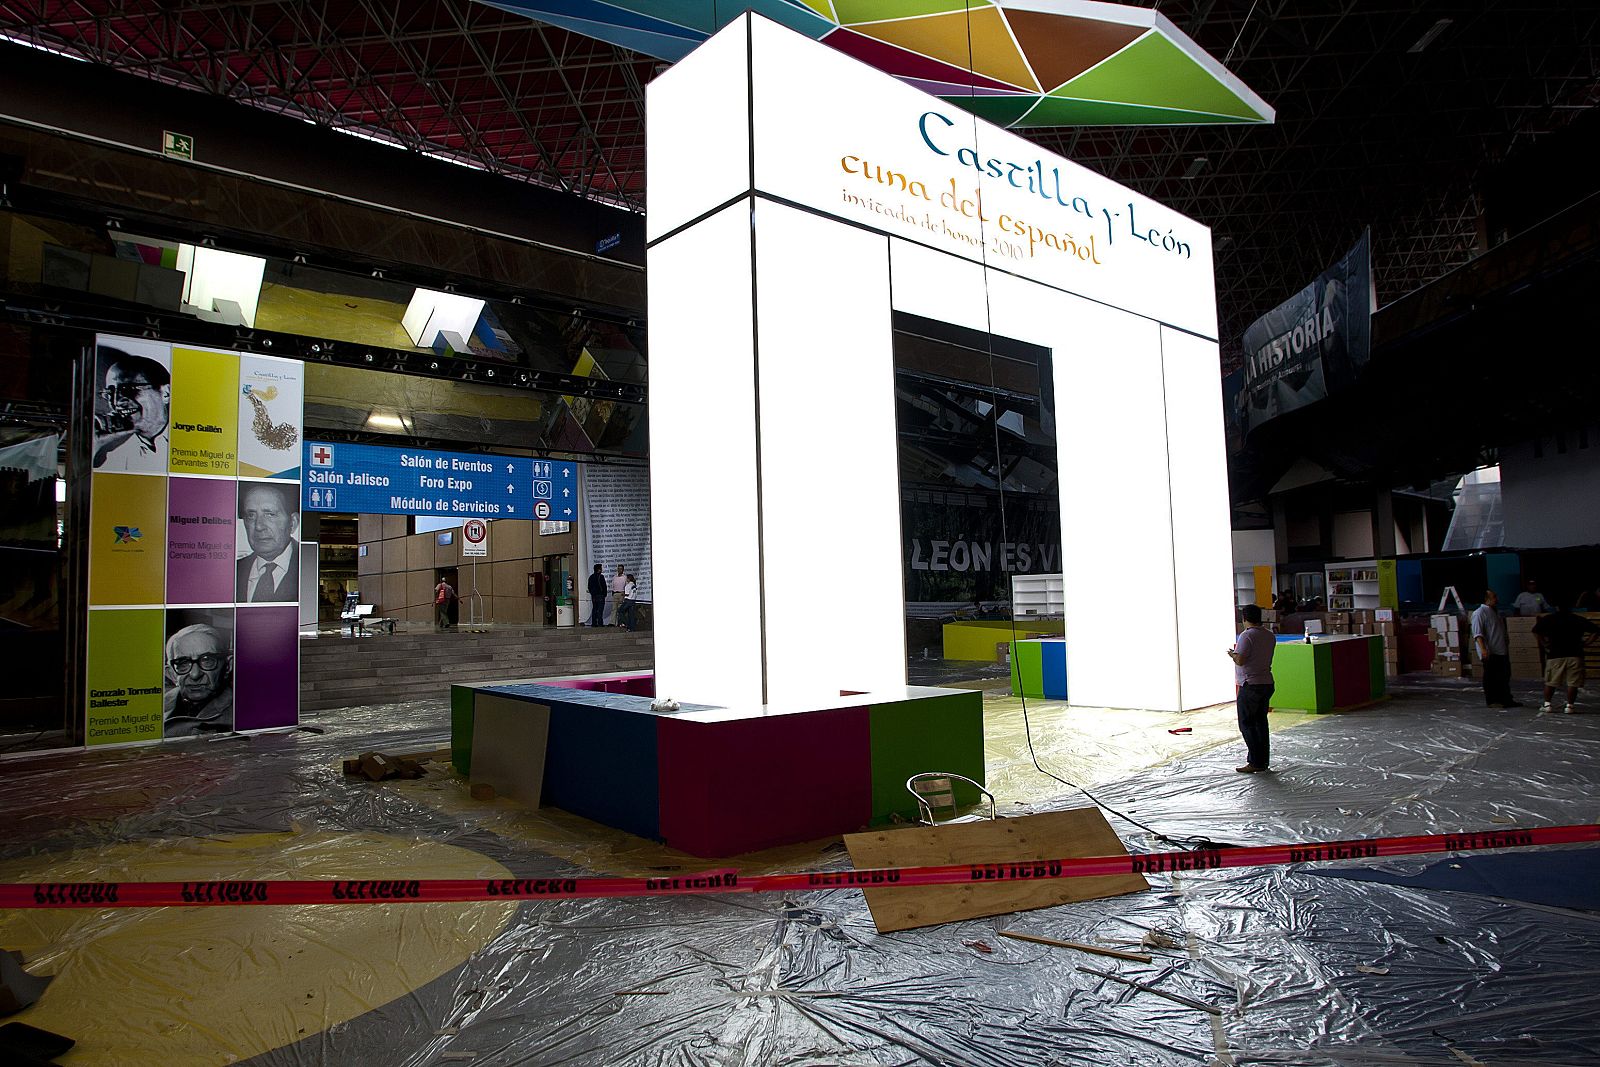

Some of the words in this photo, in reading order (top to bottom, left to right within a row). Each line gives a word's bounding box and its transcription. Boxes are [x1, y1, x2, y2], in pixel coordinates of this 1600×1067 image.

[918, 111, 1094, 219] Castilla
[1102, 207, 1120, 246] y
[1128, 202, 1192, 260] León
[840, 154, 932, 202] cuna
[940, 177, 989, 222] del
[998, 213, 1102, 265] español
[842, 188, 918, 225] invitada
[921, 213, 940, 232] de
[1257, 306, 1335, 376] HISTORIA
[172, 422, 195, 433] Jorge
[196, 424, 223, 434] Guillén
[171, 447, 198, 458] Premio
[199, 449, 224, 460] Miguel
[225, 452, 235, 460] de
[171, 457, 209, 468] Cervantes
[211, 460, 230, 469] 1976
[400, 454, 432, 469] Salón
[435, 457, 449, 470] de
[451, 458, 493, 473] Eventos
[308, 469, 344, 485] Salón
[347, 472, 390, 487] Jalisco
[420, 475, 445, 489] Foro
[447, 477, 473, 491] Expo
[390, 496, 432, 511] Módulo
[435, 499, 449, 511] de
[451, 500, 500, 514] Servicios
[169, 515, 200, 526] Miguel
[201, 516, 232, 525] Delibes
[169, 540, 196, 550] Premio
[197, 541, 222, 551] Miguel
[911, 533, 992, 572] LEÓN
[1000, 542, 1032, 572] ES
[169, 550, 207, 560] Cervantes
[90, 688, 126, 698] Gonzalo
[127, 687, 162, 696] Torrente
[89, 698, 129, 708] Ballester
[89, 716, 120, 726] Premio
[121, 713, 149, 725] Miguel
[150, 713, 161, 721] de
[89, 727, 132, 738] Cervantes
[135, 723, 156, 734] 1985
